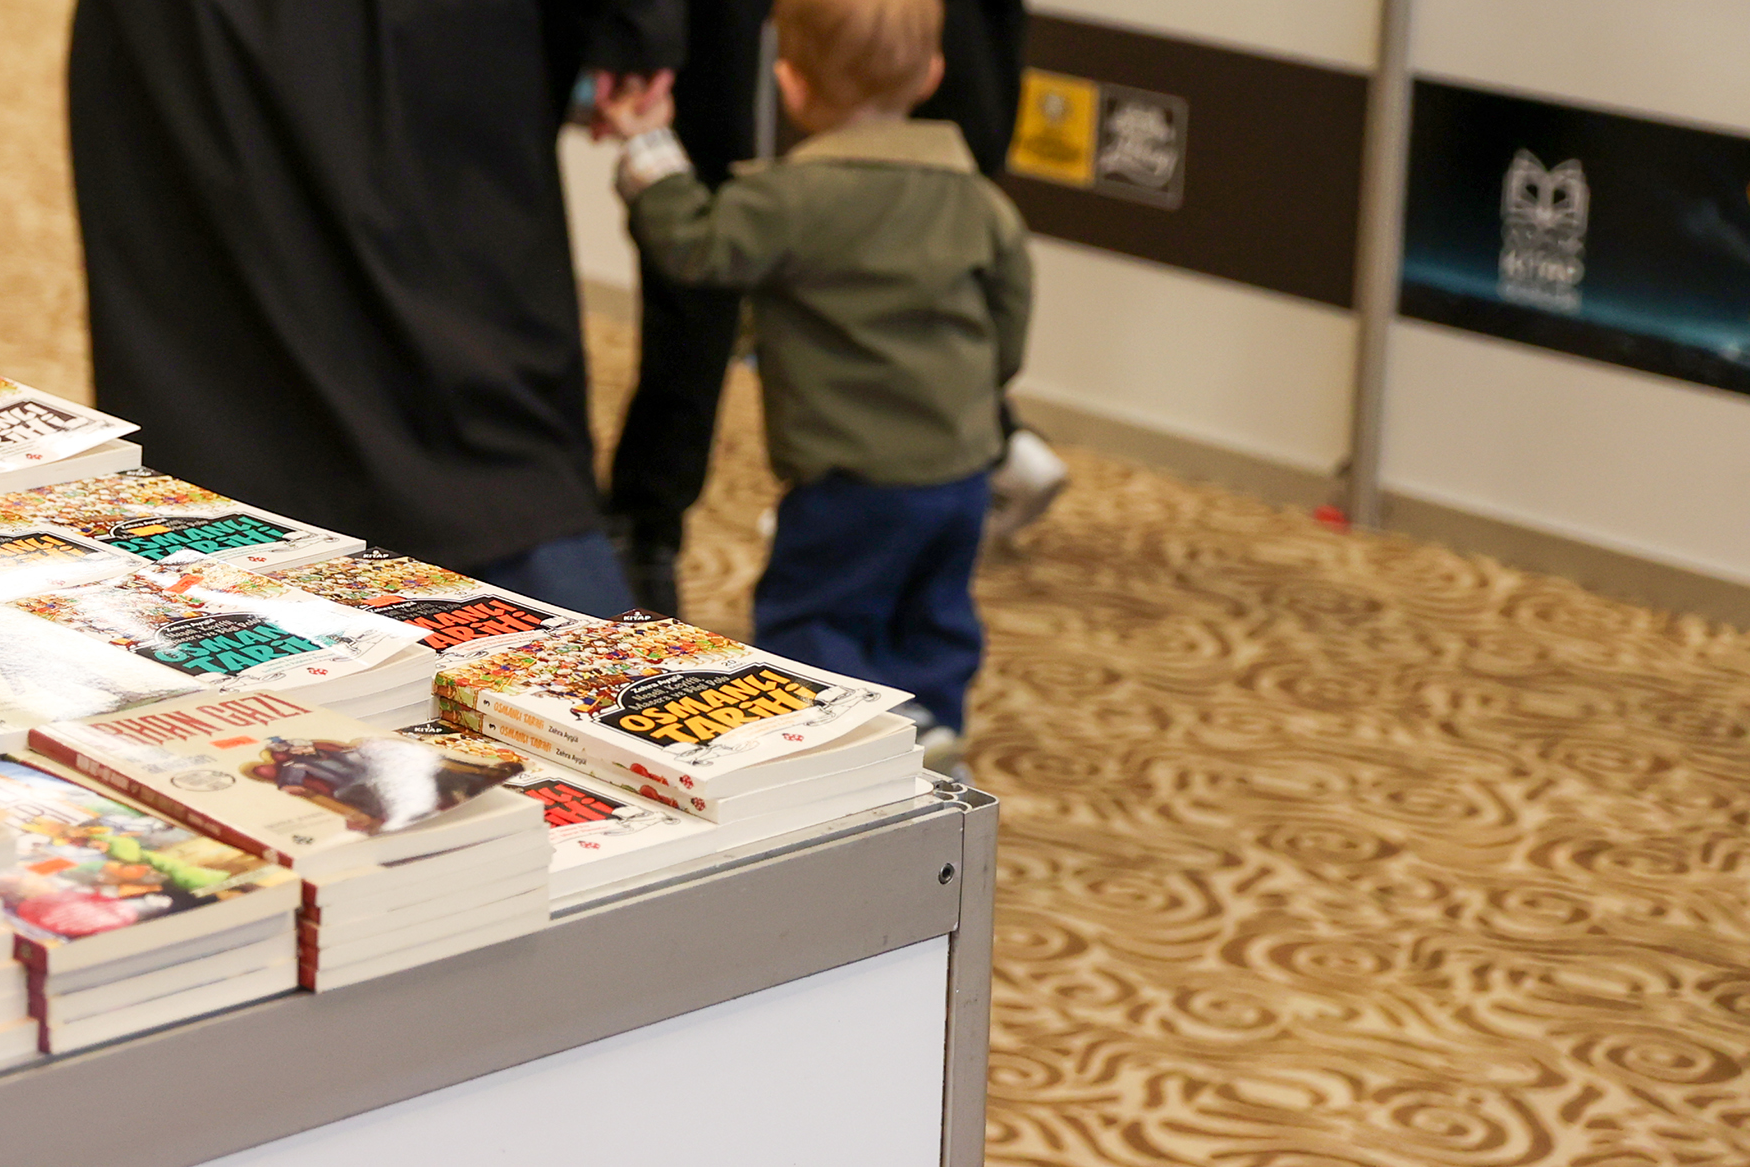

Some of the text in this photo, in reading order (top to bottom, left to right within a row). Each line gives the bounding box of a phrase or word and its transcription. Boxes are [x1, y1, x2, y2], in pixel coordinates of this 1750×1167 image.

[109, 515, 264, 553] OSMANLI
[403, 599, 518, 631] MANLI
[419, 611, 543, 650] ARİHİ
[623, 612, 652, 622] KİTAP
[154, 622, 291, 663] OSMAN
[183, 638, 325, 675] TARİH
[88, 692, 313, 746] RHAN GAZİ
[619, 669, 791, 732] OSMANLI
[649, 683, 818, 744] TARİHİ
